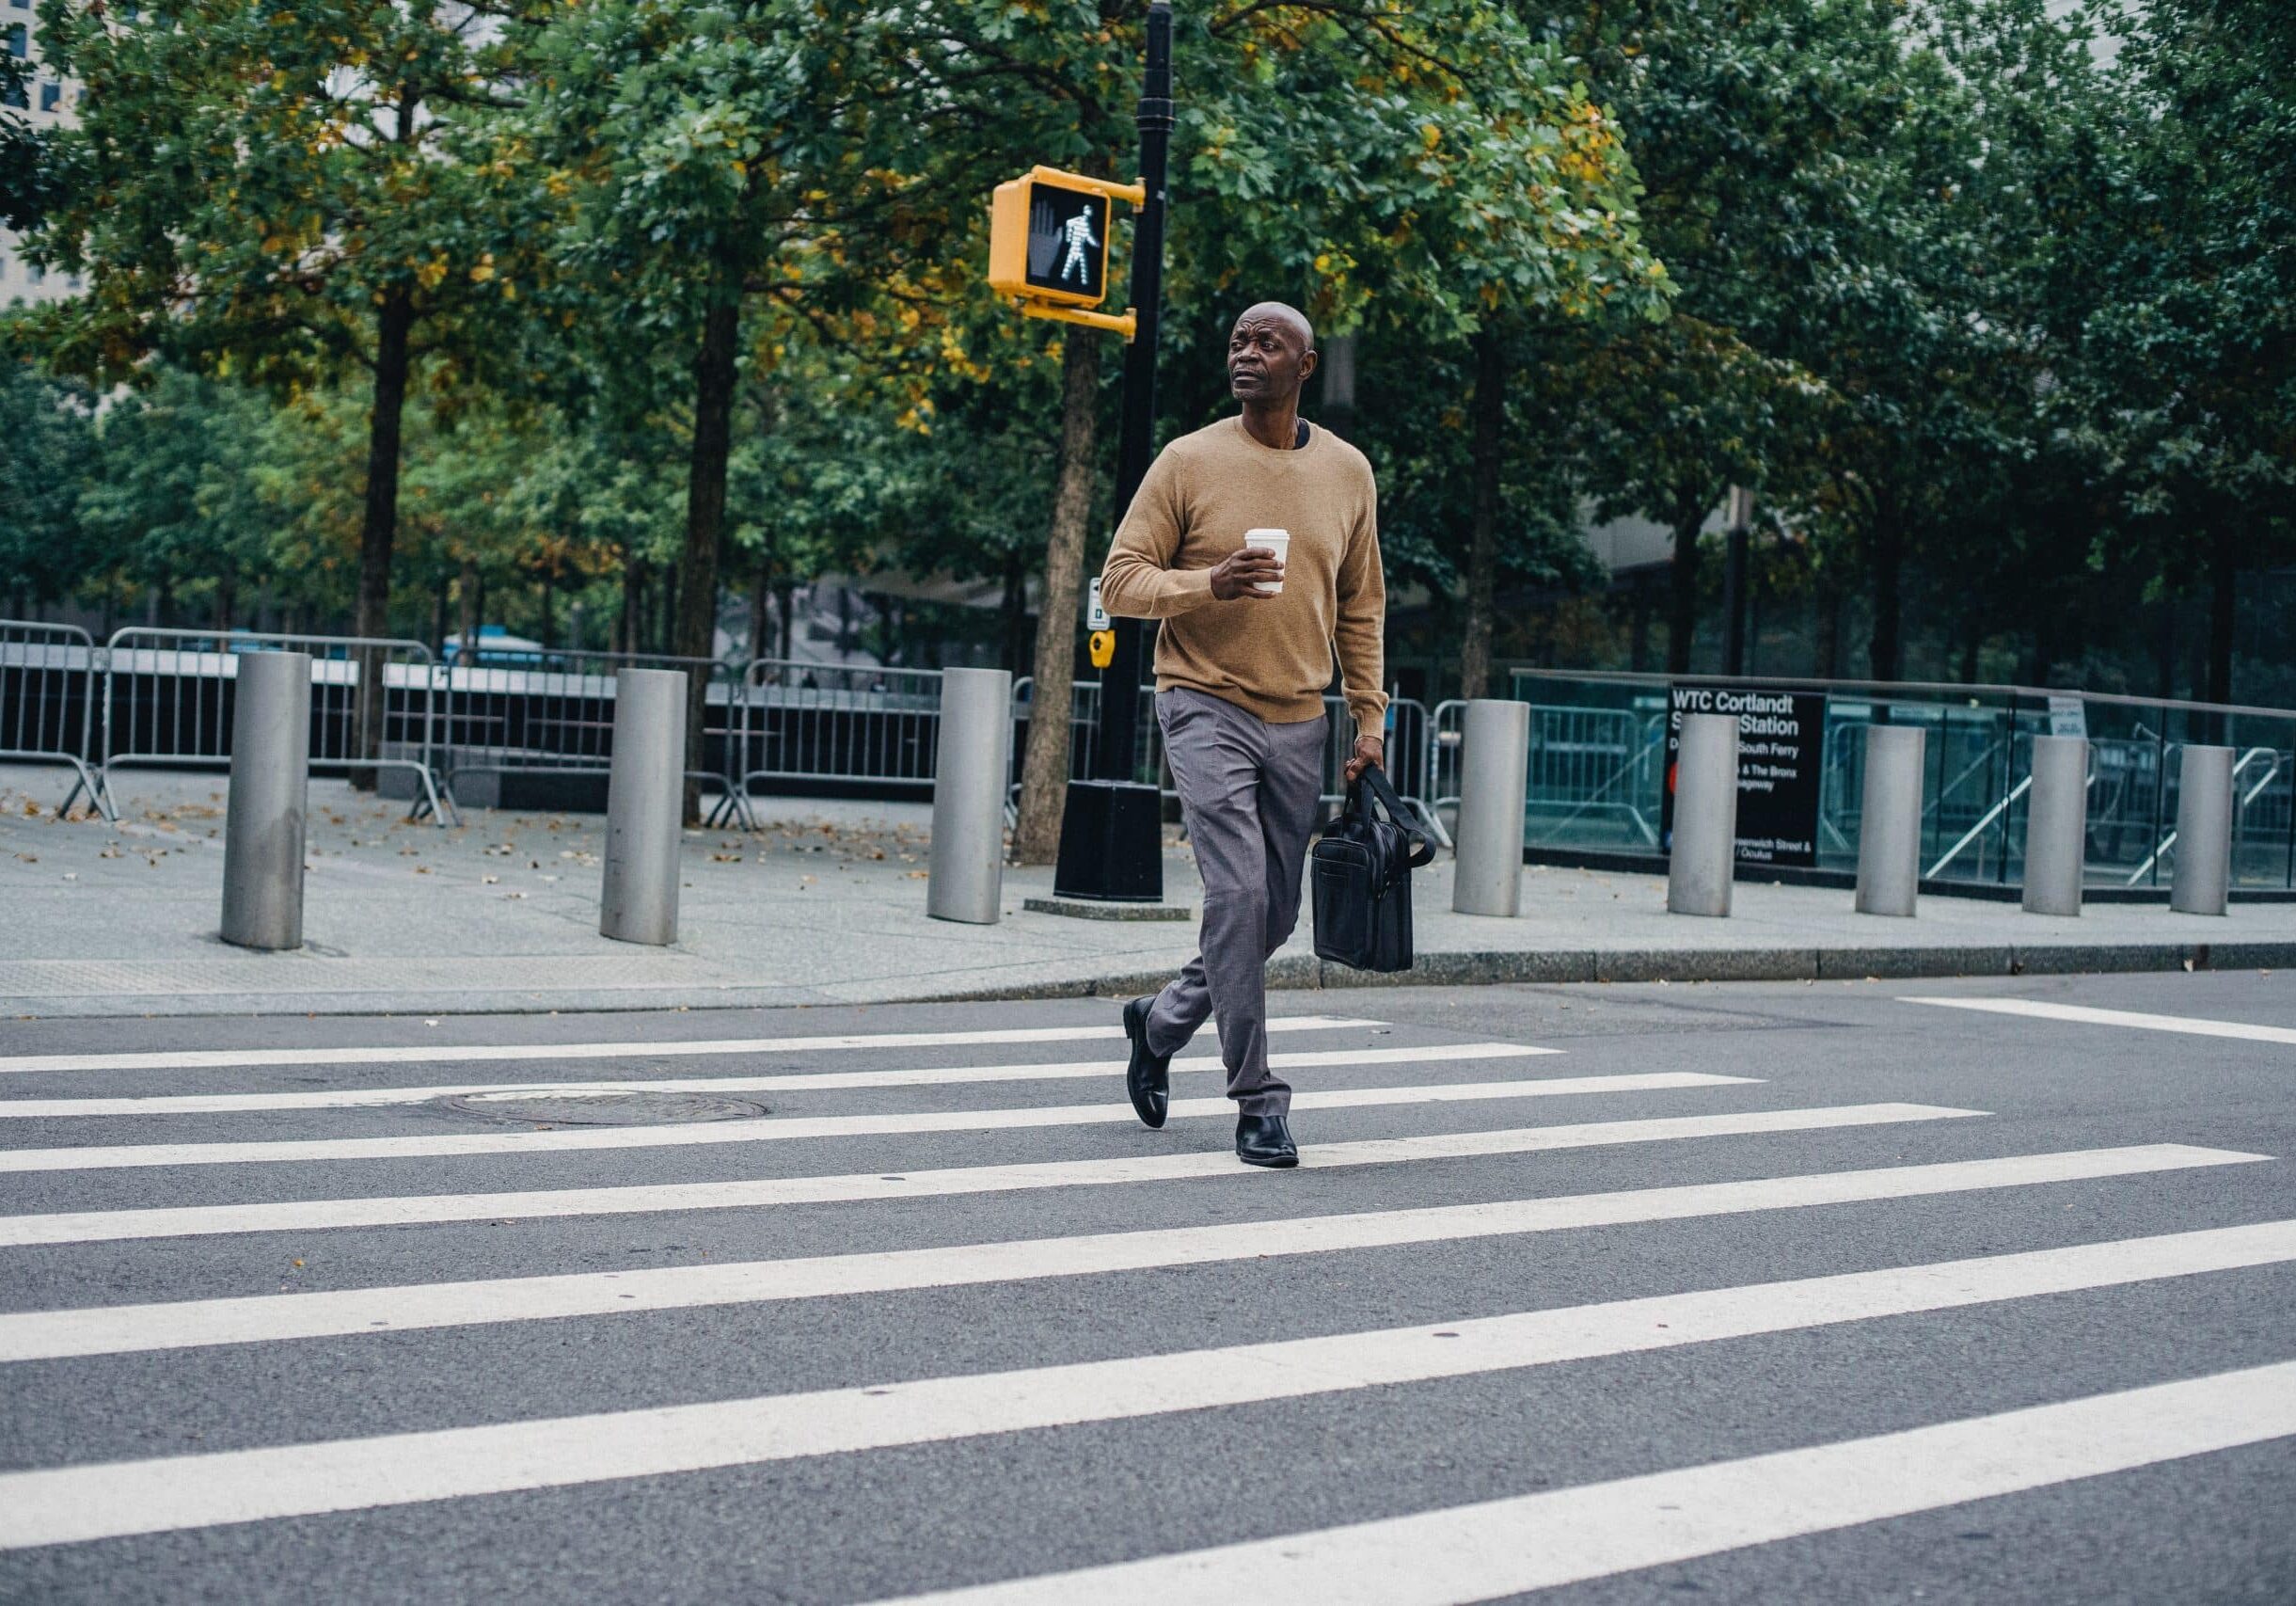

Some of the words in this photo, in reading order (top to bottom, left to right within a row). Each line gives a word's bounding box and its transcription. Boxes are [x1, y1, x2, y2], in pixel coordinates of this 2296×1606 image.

[1672, 690, 1712, 709] WTC
[1716, 692, 1794, 713] Cortlandt
[1740, 714, 1798, 735] Station
[1737, 740, 1768, 755] South
[1770, 742, 1798, 759] Ferry
[1750, 764, 1768, 776] The
[1769, 765, 1797, 778] Bronx
